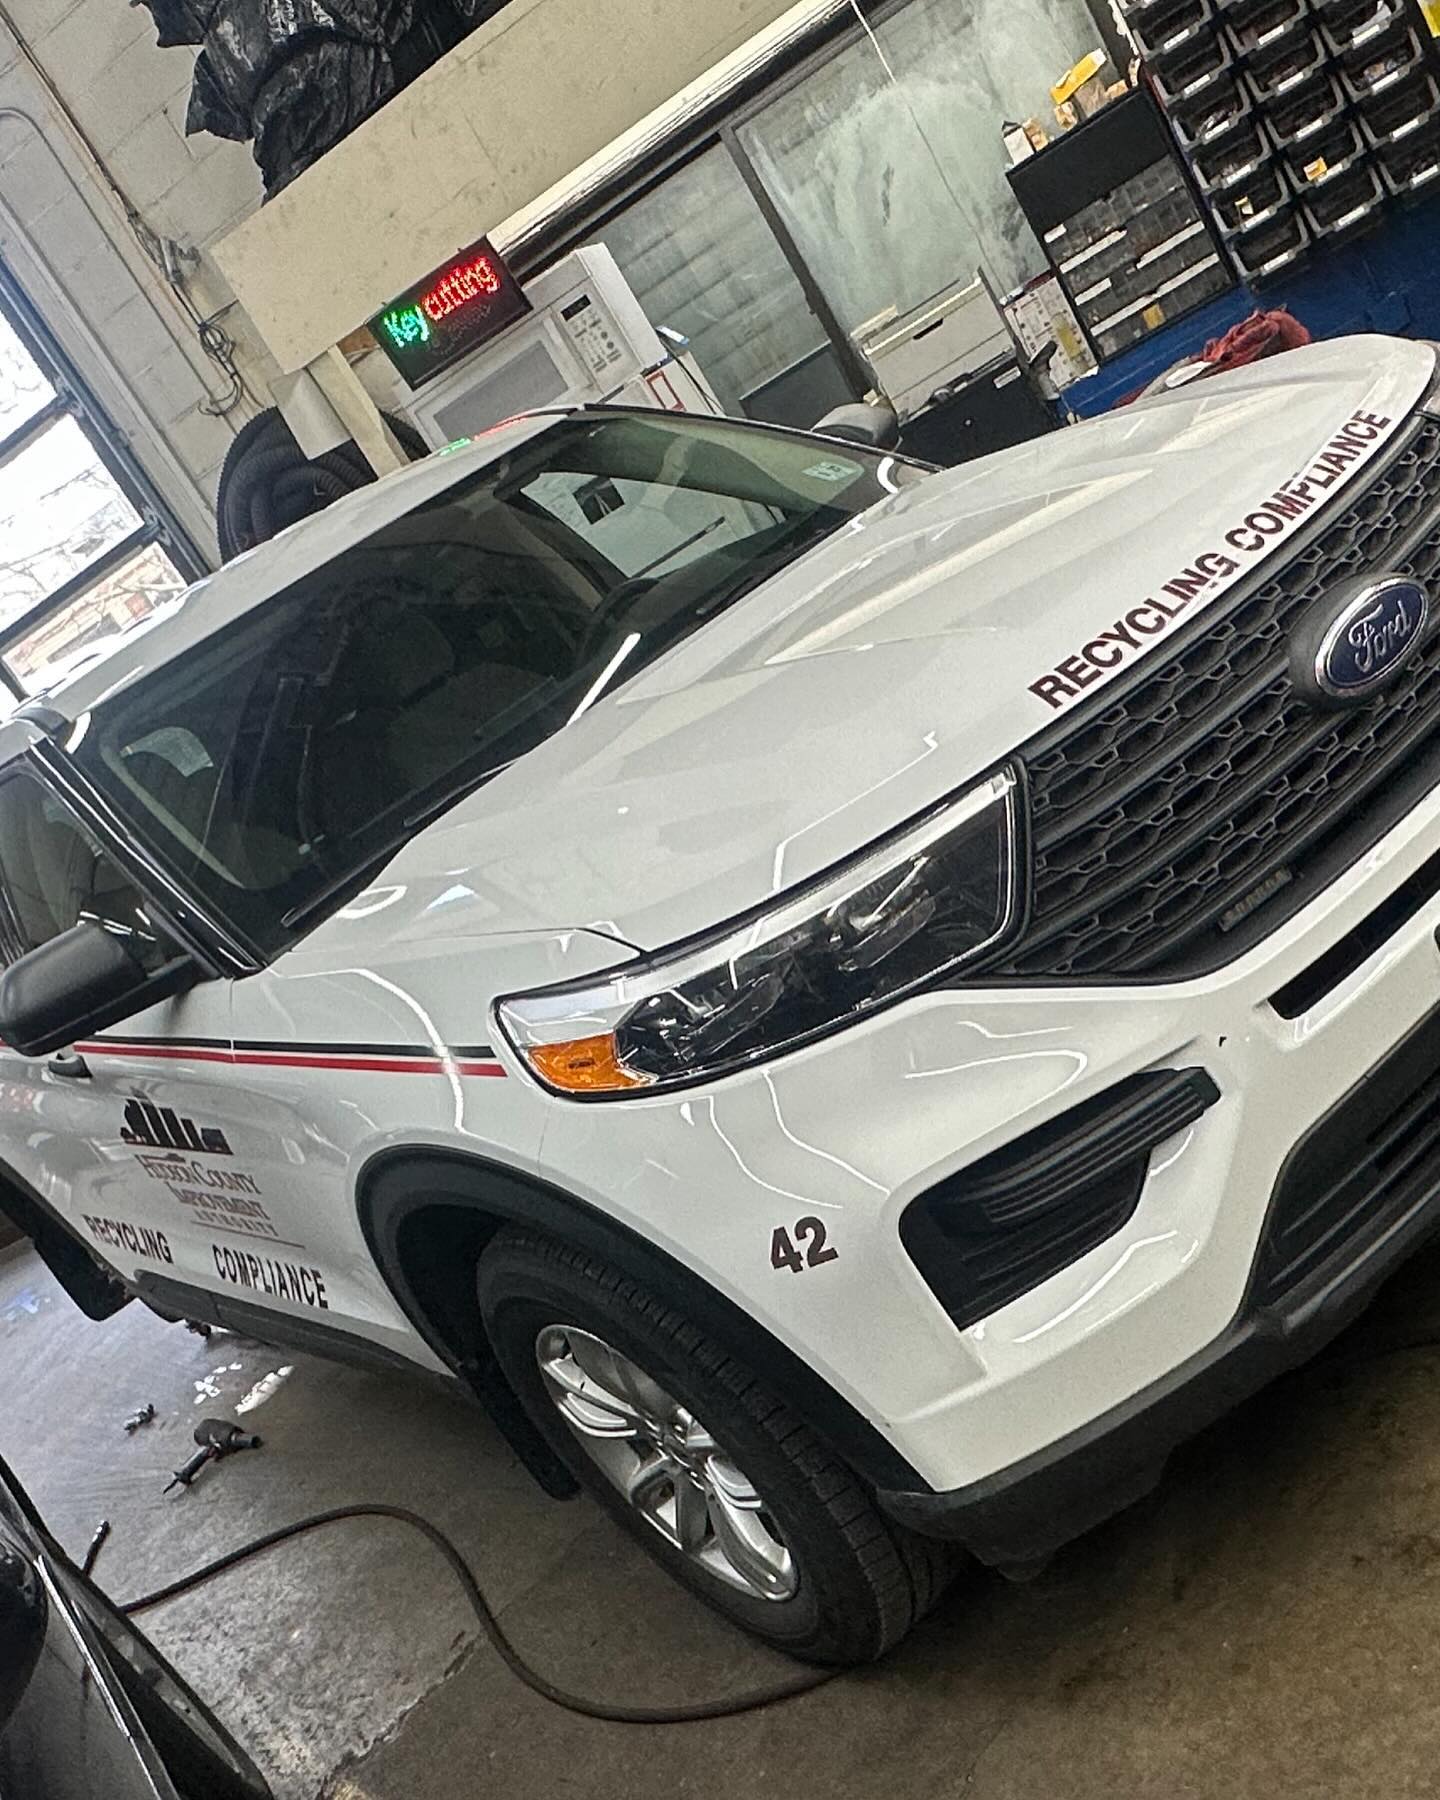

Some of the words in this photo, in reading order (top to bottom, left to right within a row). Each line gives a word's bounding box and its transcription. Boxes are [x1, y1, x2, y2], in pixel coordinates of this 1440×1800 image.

[383, 304, 430, 348] Key
[421, 256, 500, 321] cutting
[1027, 553, 1240, 709] RECYCLING
[1225, 410, 1392, 551] COMPLIANCE
[1348, 600, 1411, 673] Ford
[81, 1213, 174, 1264] RECYCLING
[212, 1244, 328, 1309] COMPLIANCE
[771, 1216, 839, 1273] 42
